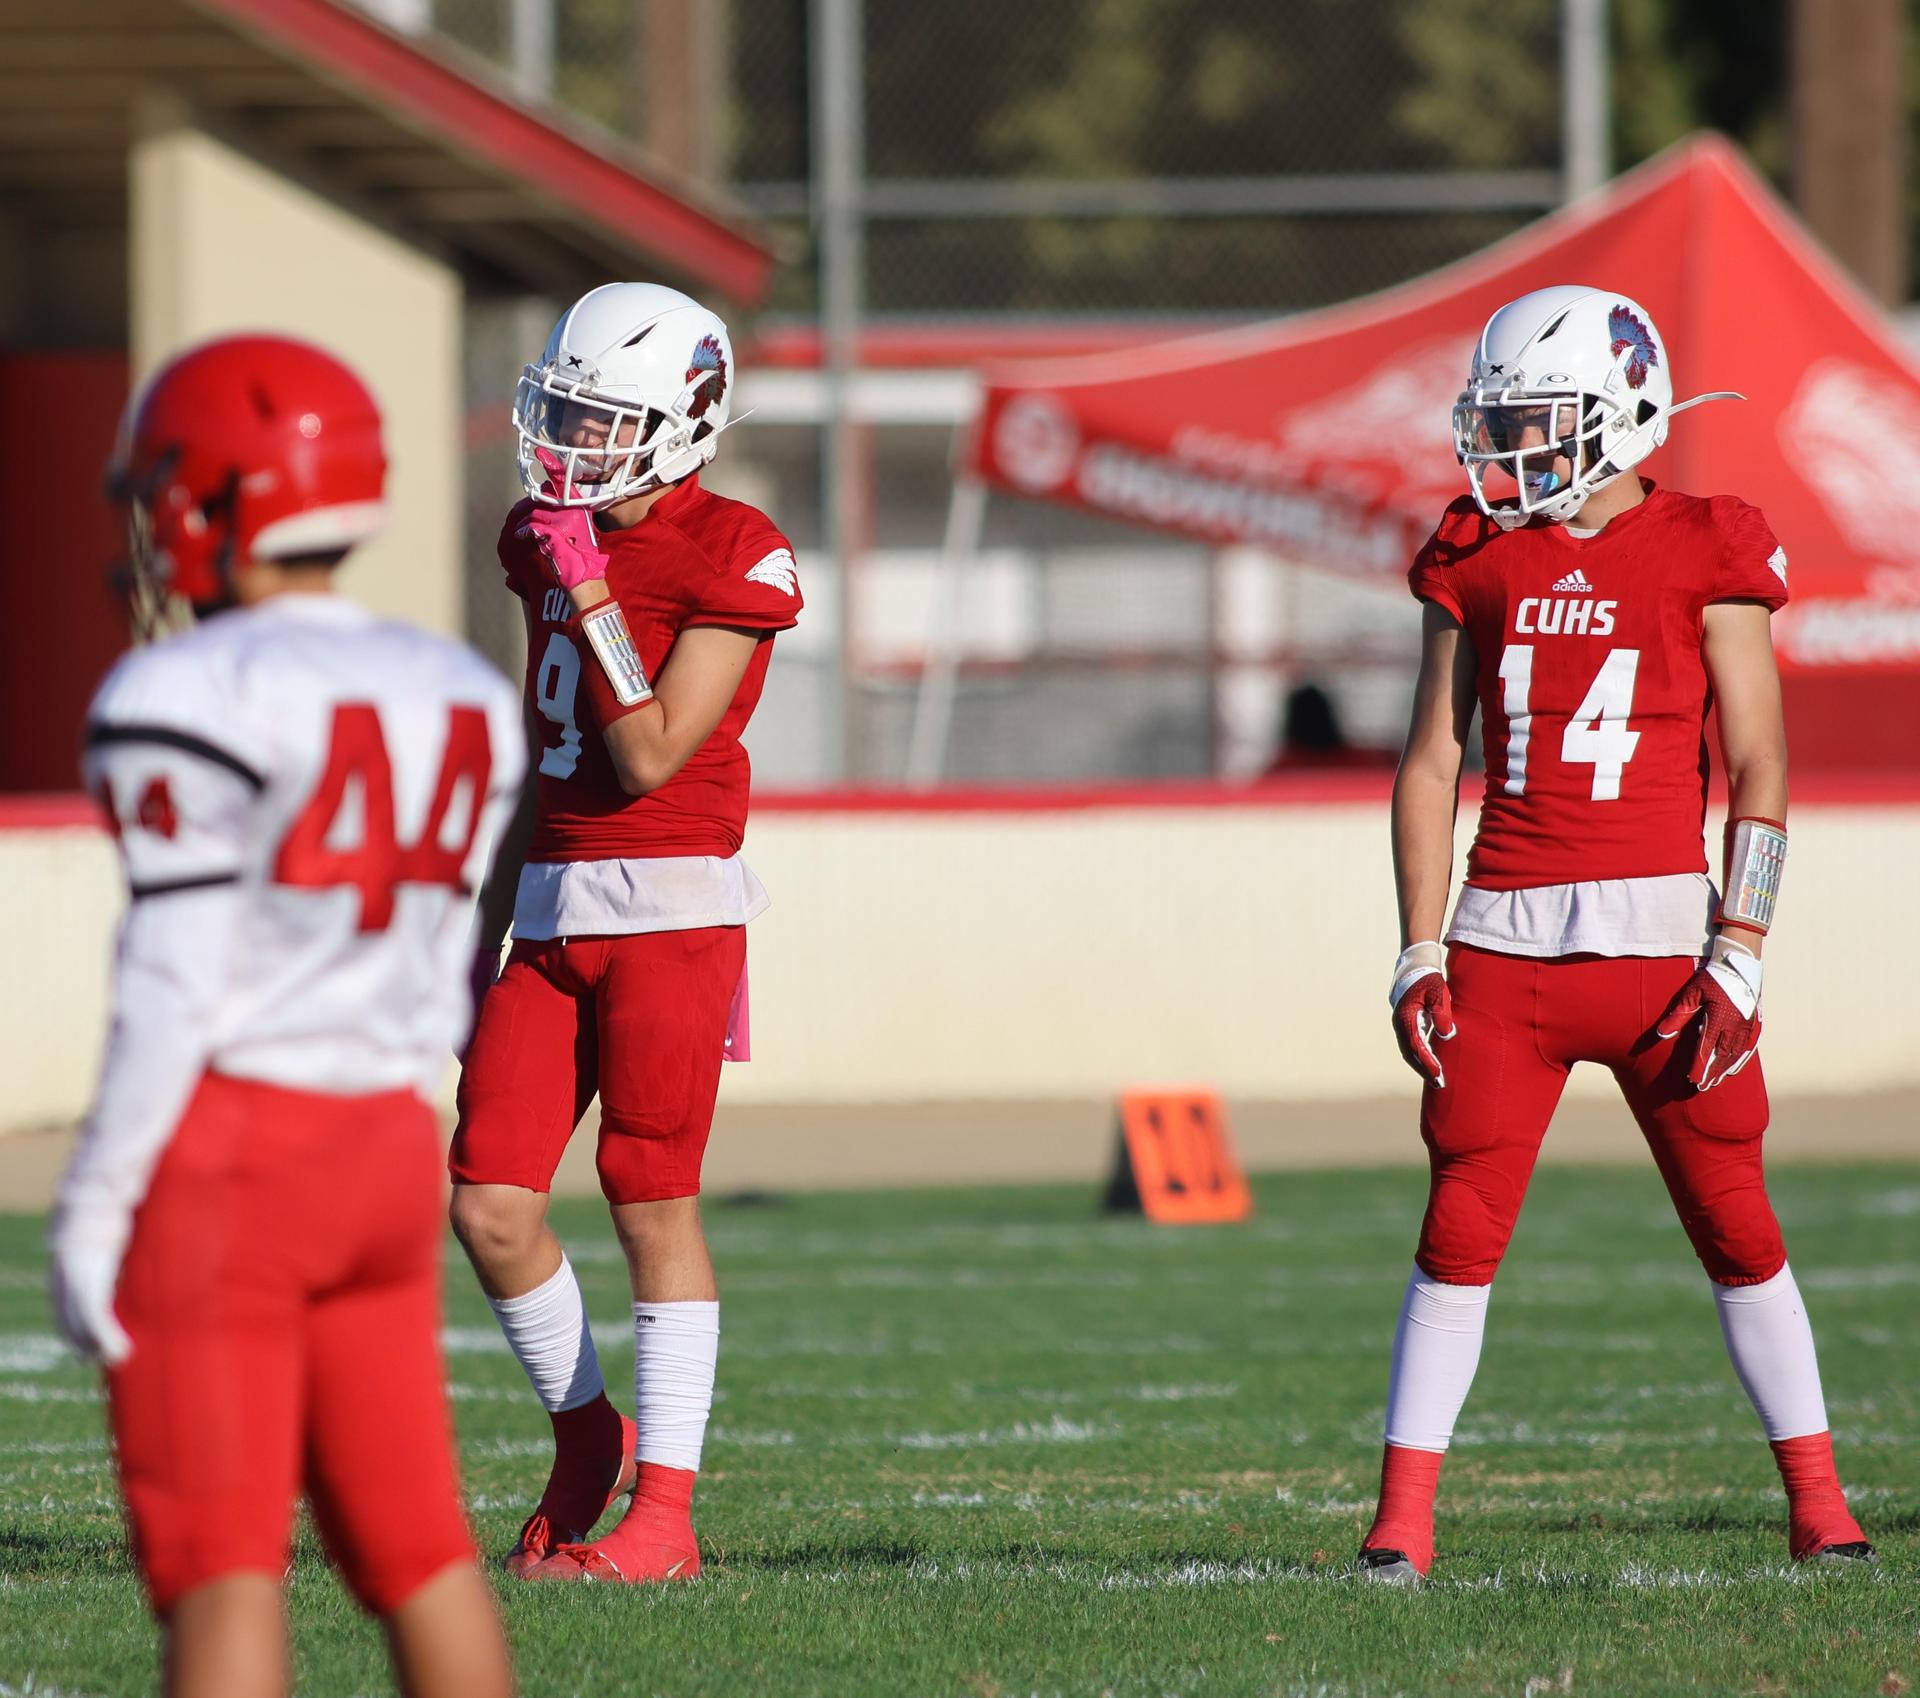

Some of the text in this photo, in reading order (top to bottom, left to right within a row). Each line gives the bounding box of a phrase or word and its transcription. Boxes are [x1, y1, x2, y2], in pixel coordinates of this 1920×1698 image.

[1515, 598, 1618, 635] CUHS
[1552, 582, 1593, 593] adidas
[536, 632, 583, 780] 9
[1498, 644, 1641, 801] 14
[271, 701, 493, 934] 44
